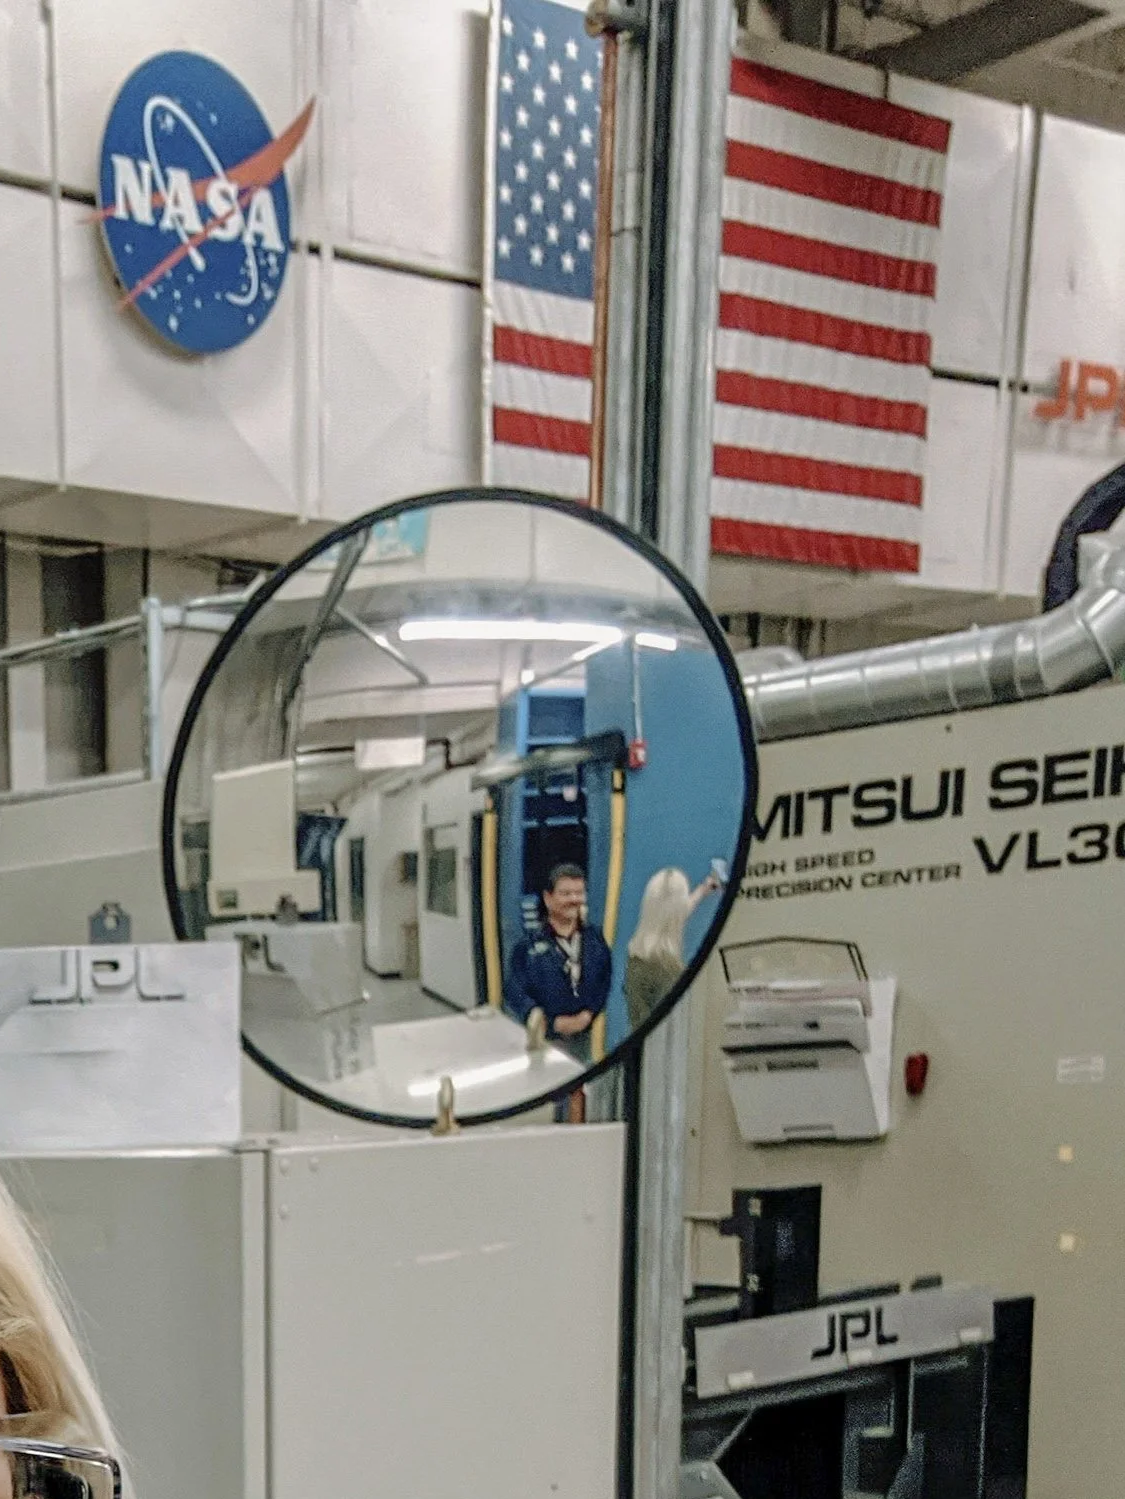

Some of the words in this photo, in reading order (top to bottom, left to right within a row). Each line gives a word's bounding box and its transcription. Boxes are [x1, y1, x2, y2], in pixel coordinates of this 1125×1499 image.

[111, 153, 285, 253] NASA
[1033, 359, 1125, 429] JP
[744, 860, 787, 878] IGH
[794, 848, 874, 873] SPEED
[860, 863, 962, 889] CENTER
[28, 946, 186, 1004] JPL
[811, 1306, 899, 1360] JPL
